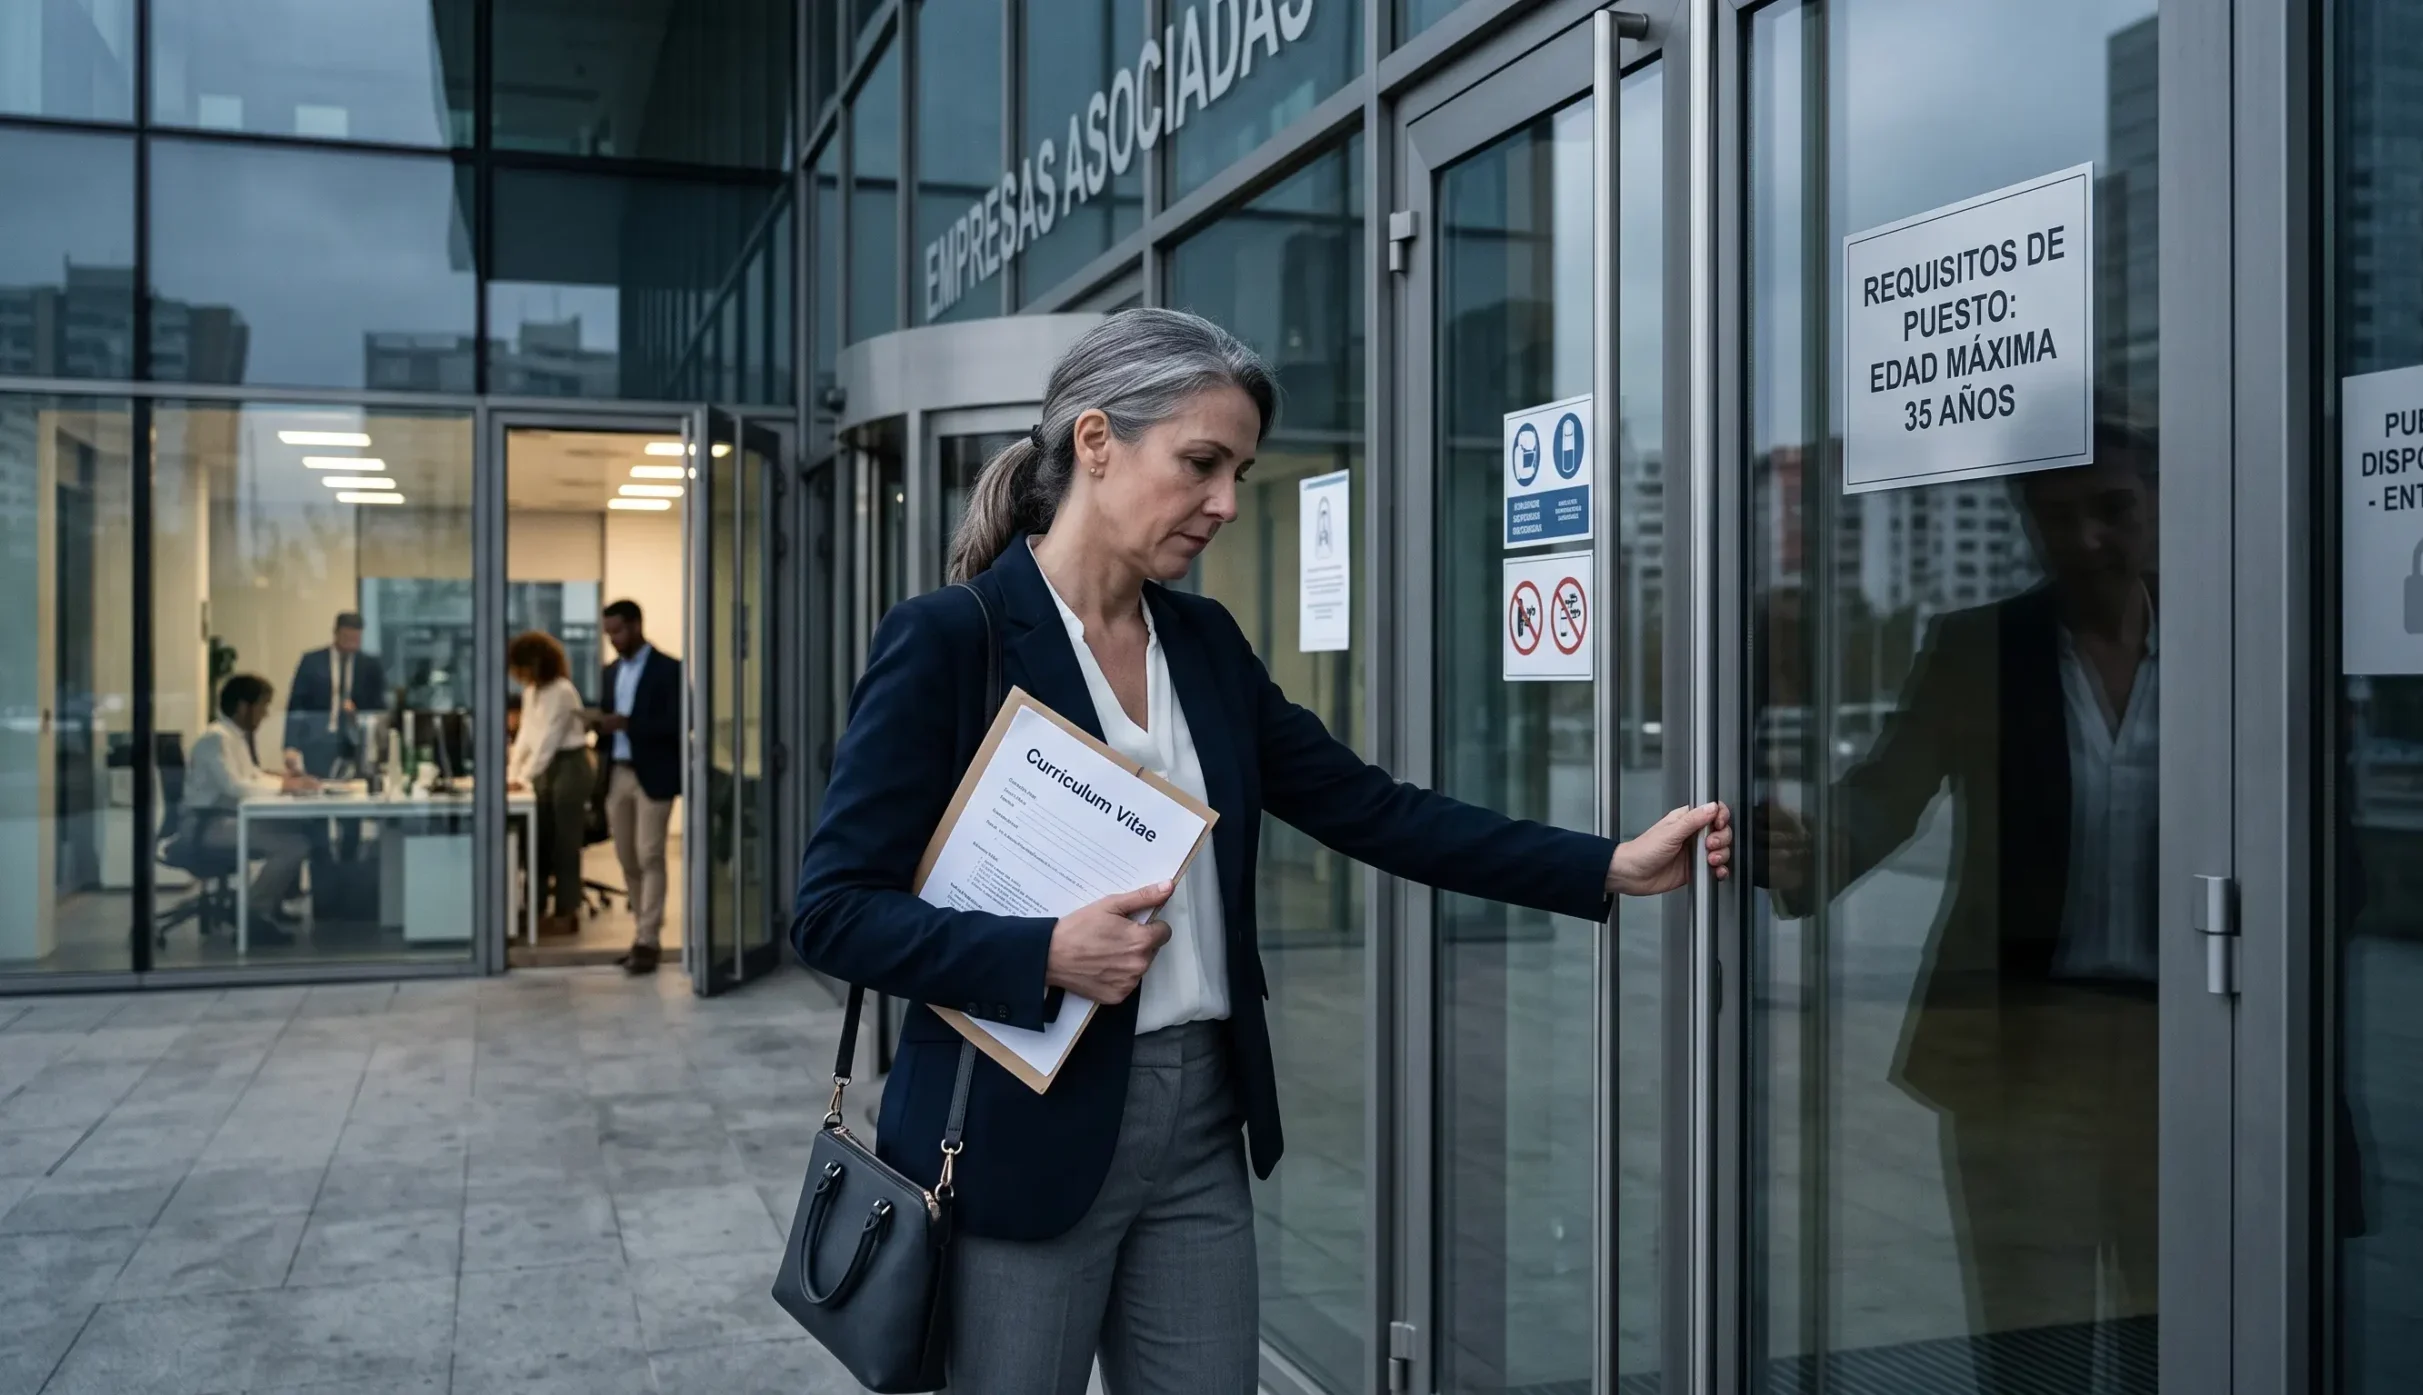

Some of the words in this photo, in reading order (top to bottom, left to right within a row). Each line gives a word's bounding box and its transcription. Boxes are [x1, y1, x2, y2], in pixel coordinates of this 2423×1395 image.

[925, 138, 1056, 323] EMPRESAS
[1864, 239, 2017, 307] REQUISITOS
[2027, 225, 2065, 267] DE
[1904, 289, 2016, 342] PUESTO:
[1870, 352, 1938, 393] EDAD
[1946, 327, 2057, 379] MÁXIMA
[1904, 398, 1932, 432] 35
[1938, 383, 2015, 426] AÑOS
[1026, 748, 1113, 814] Curriculum
[1117, 804, 1157, 843] Vitae
